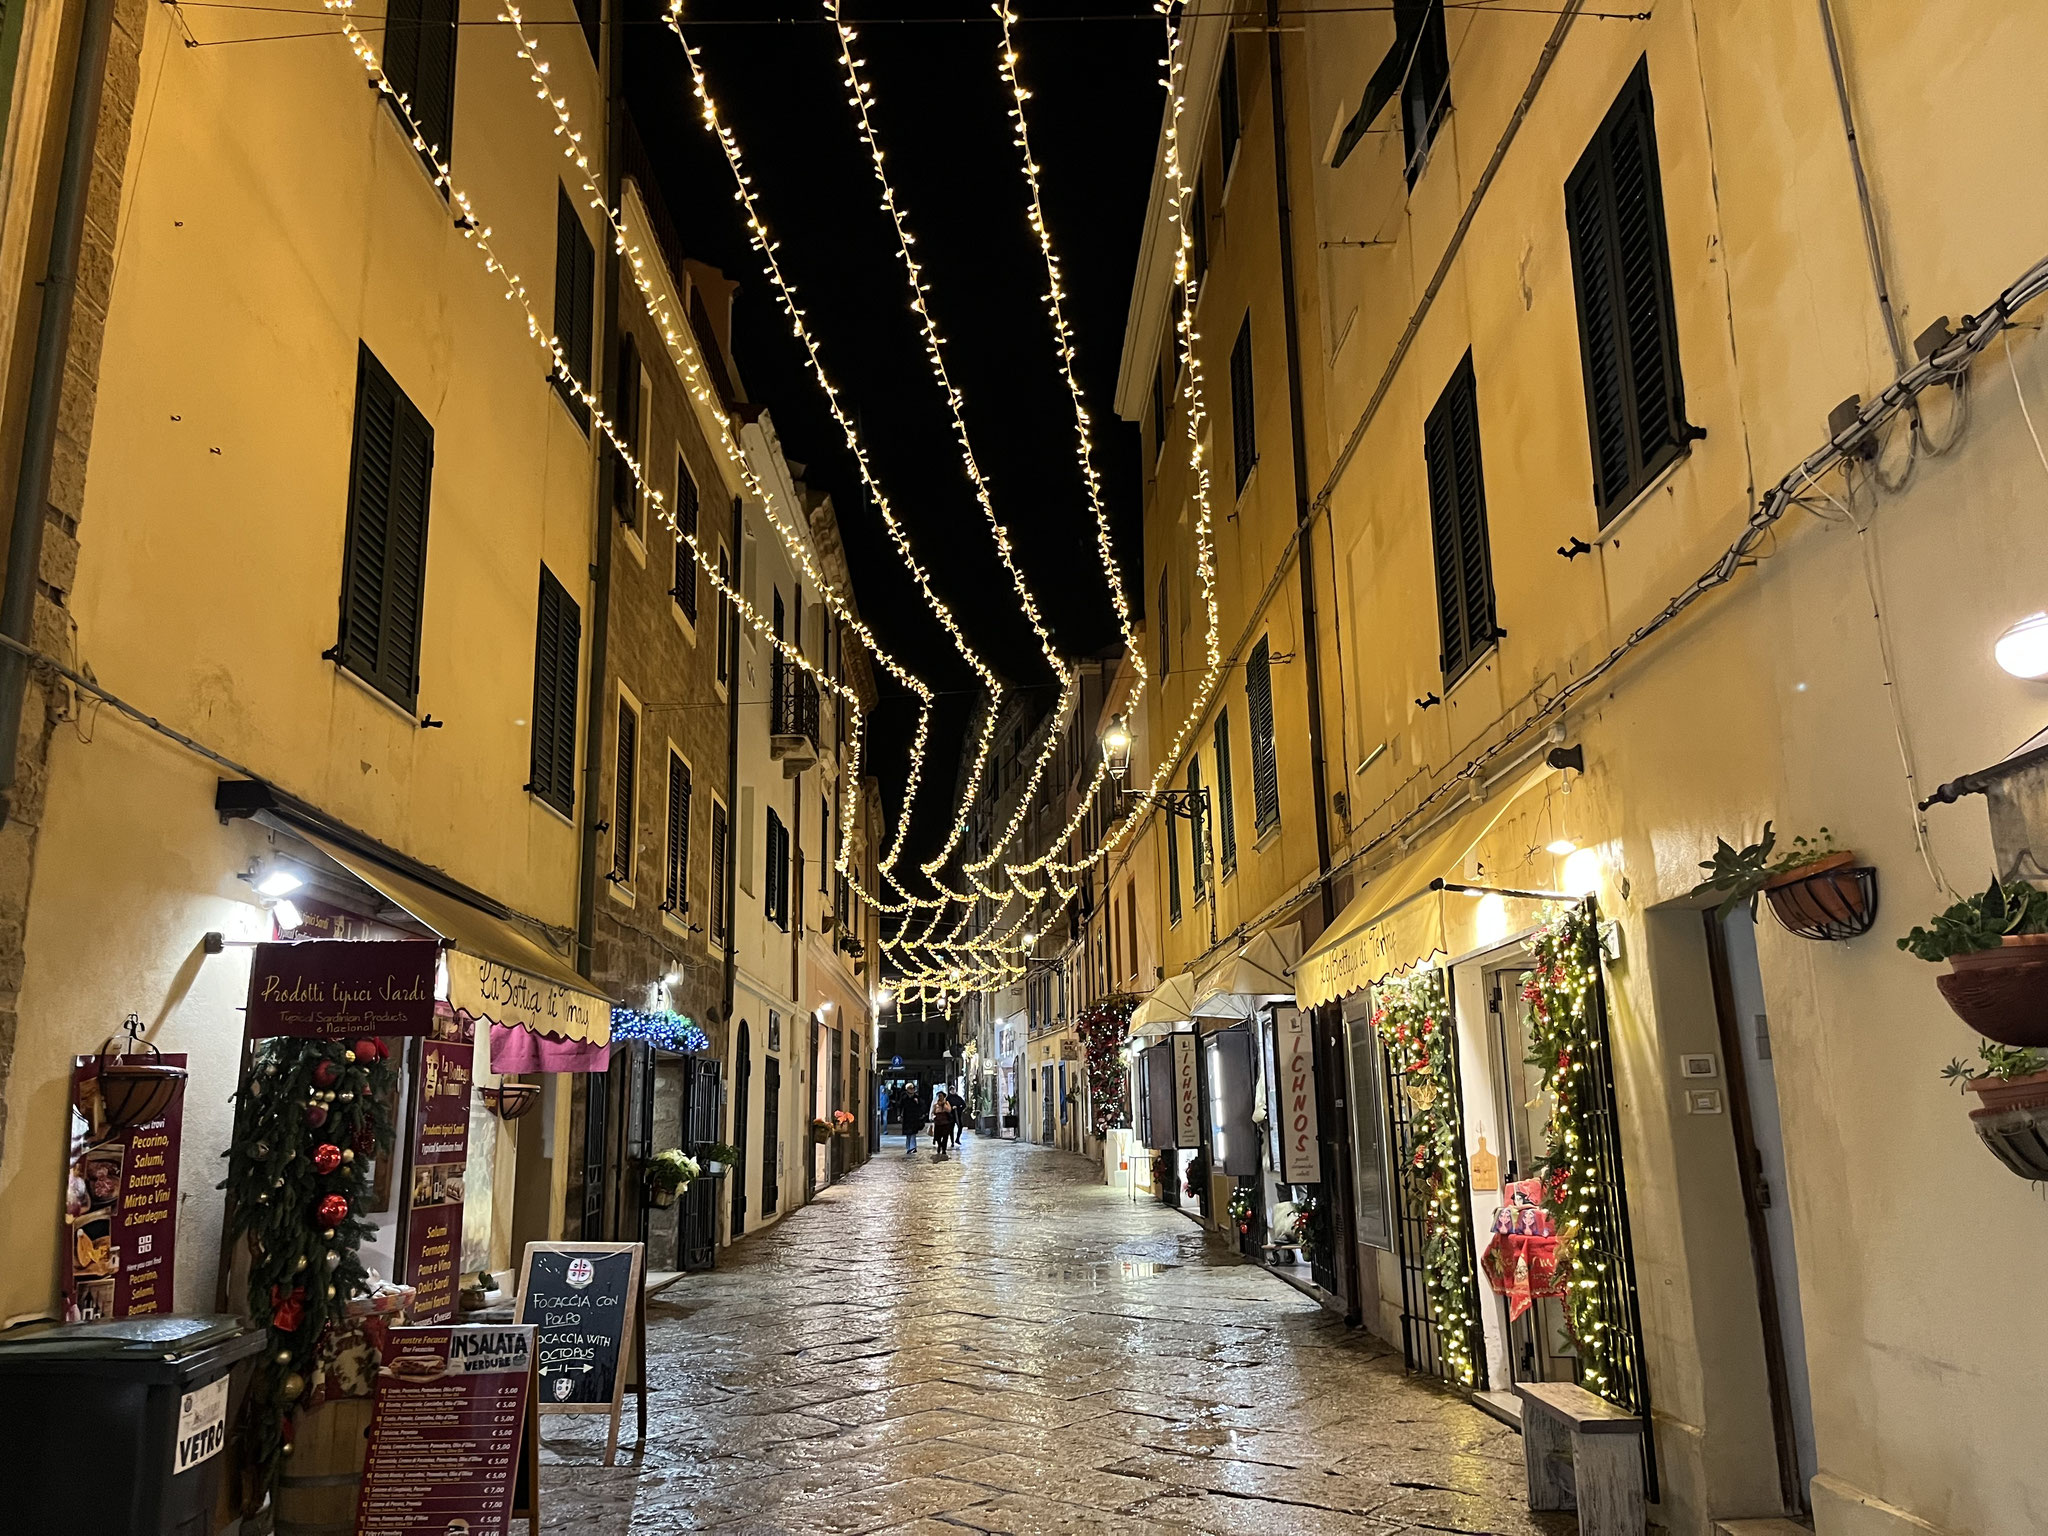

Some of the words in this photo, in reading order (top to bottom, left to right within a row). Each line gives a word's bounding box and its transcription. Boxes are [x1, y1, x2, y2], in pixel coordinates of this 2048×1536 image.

[261, 975, 325, 1003] Prodotti
[332, 980, 372, 1014] tipici
[379, 973, 427, 1002] Sardi
[280, 1010, 314, 1024] Typical
[316, 1011, 361, 1023] Sardinian
[364, 1010, 409, 1022] Products
[326, 1021, 376, 1033] Nazionali
[1291, 1036, 1310, 1152] ICHNOS
[132, 1133, 170, 1149] Pecorino,
[134, 1151, 165, 1169] Salumi,
[129, 1173, 167, 1189] Bottarga,
[124, 1193, 148, 1209] Mirto
[148, 1194, 154, 1204] e
[155, 1187, 171, 1203] Vini
[124, 1213, 133, 1227] di
[133, 1209, 168, 1224] Sardegna
[533, 1293, 591, 1309] FOCACCIA
[545, 1312, 581, 1326] POLPO
[450, 1333, 528, 1359] INSALATA
[537, 1333, 584, 1345] OCACCIA
[586, 1334, 611, 1347] WITH
[539, 1347, 595, 1363] OCTOPUS
[180, 1419, 223, 1468] VETRO
